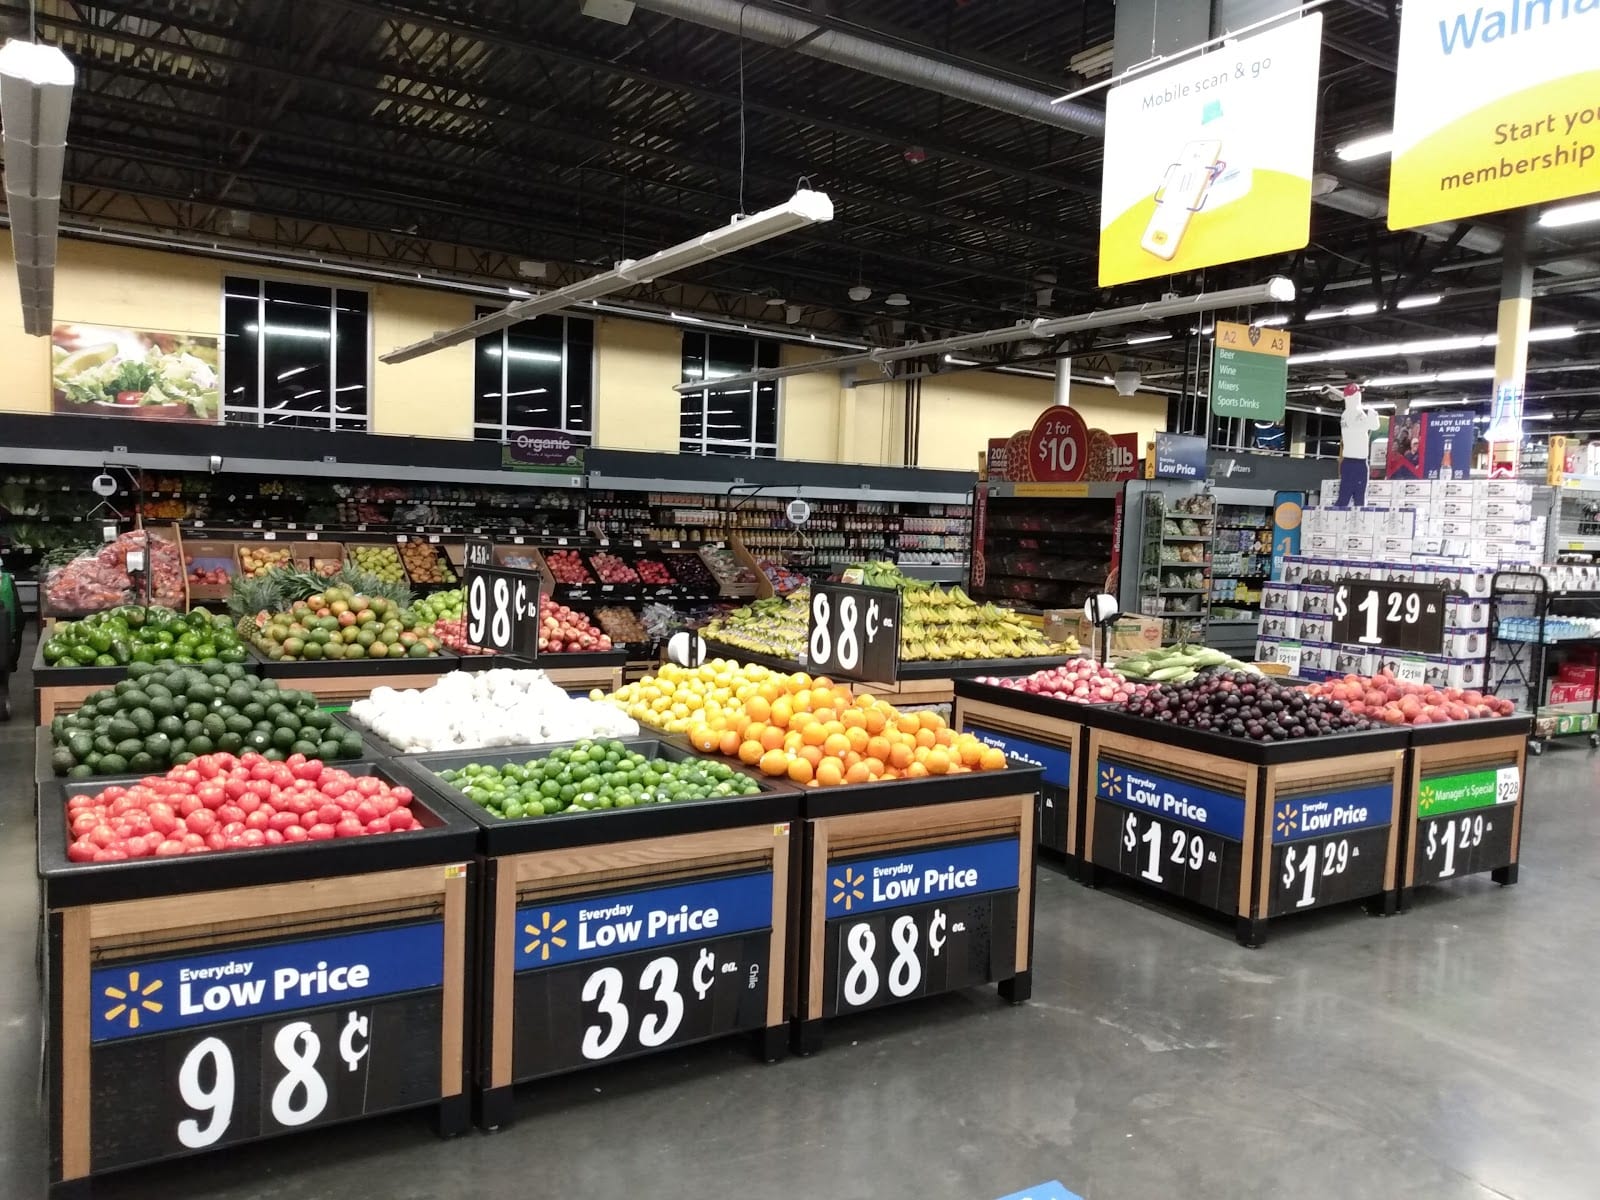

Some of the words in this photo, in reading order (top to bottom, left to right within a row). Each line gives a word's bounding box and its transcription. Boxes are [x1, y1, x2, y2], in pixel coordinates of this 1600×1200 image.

[1142, 82, 1190, 111] Mobile
[1195, 72, 1228, 93] scan
[1234, 62, 1245, 80] &
[1251, 57, 1272, 79] go
[1494, 114, 1555, 145] Start
[1440, 141, 1595, 191] membership
[1223, 330, 1237, 344] A2
[1270, 338, 1284, 351] A3
[1219, 348, 1235, 359] Beer
[1219, 364, 1237, 375] Wine
[1217, 380, 1240, 391] Mixers
[1217, 395, 1239, 407] Sports
[1239, 398, 1260, 409] Drinks
[1046, 422, 1052, 435] 2
[1055, 421, 1071, 435] for
[1430, 420, 1453, 428] ENJOY
[516, 434, 571, 452] Organic
[991, 447, 1008, 459] 20%
[1039, 436, 1077, 472] $10
[1158, 461, 1176, 474] Low
[1177, 463, 1196, 476] Price
[983, 736, 1006, 749] Everyday
[1127, 774, 1156, 790] Everyday
[1435, 784, 1471, 802] Manager's
[1471, 781, 1495, 798] Special
[1126, 782, 1163, 809] Low
[1163, 792, 1208, 823] Price
[1302, 801, 1328, 814] Everyday
[1301, 811, 1332, 832] Low
[1333, 804, 1367, 825] Price
[873, 863, 914, 878] Everyday
[872, 877, 920, 903] Low
[924, 866, 978, 895] Price
[578, 903, 634, 922] Everyday
[578, 920, 642, 951] Low
[648, 905, 719, 939] Price
[179, 960, 253, 982] Everyday
[748, 963, 760, 990] Chile
[179, 978, 266, 1016] Low
[273, 961, 370, 1001] Price
